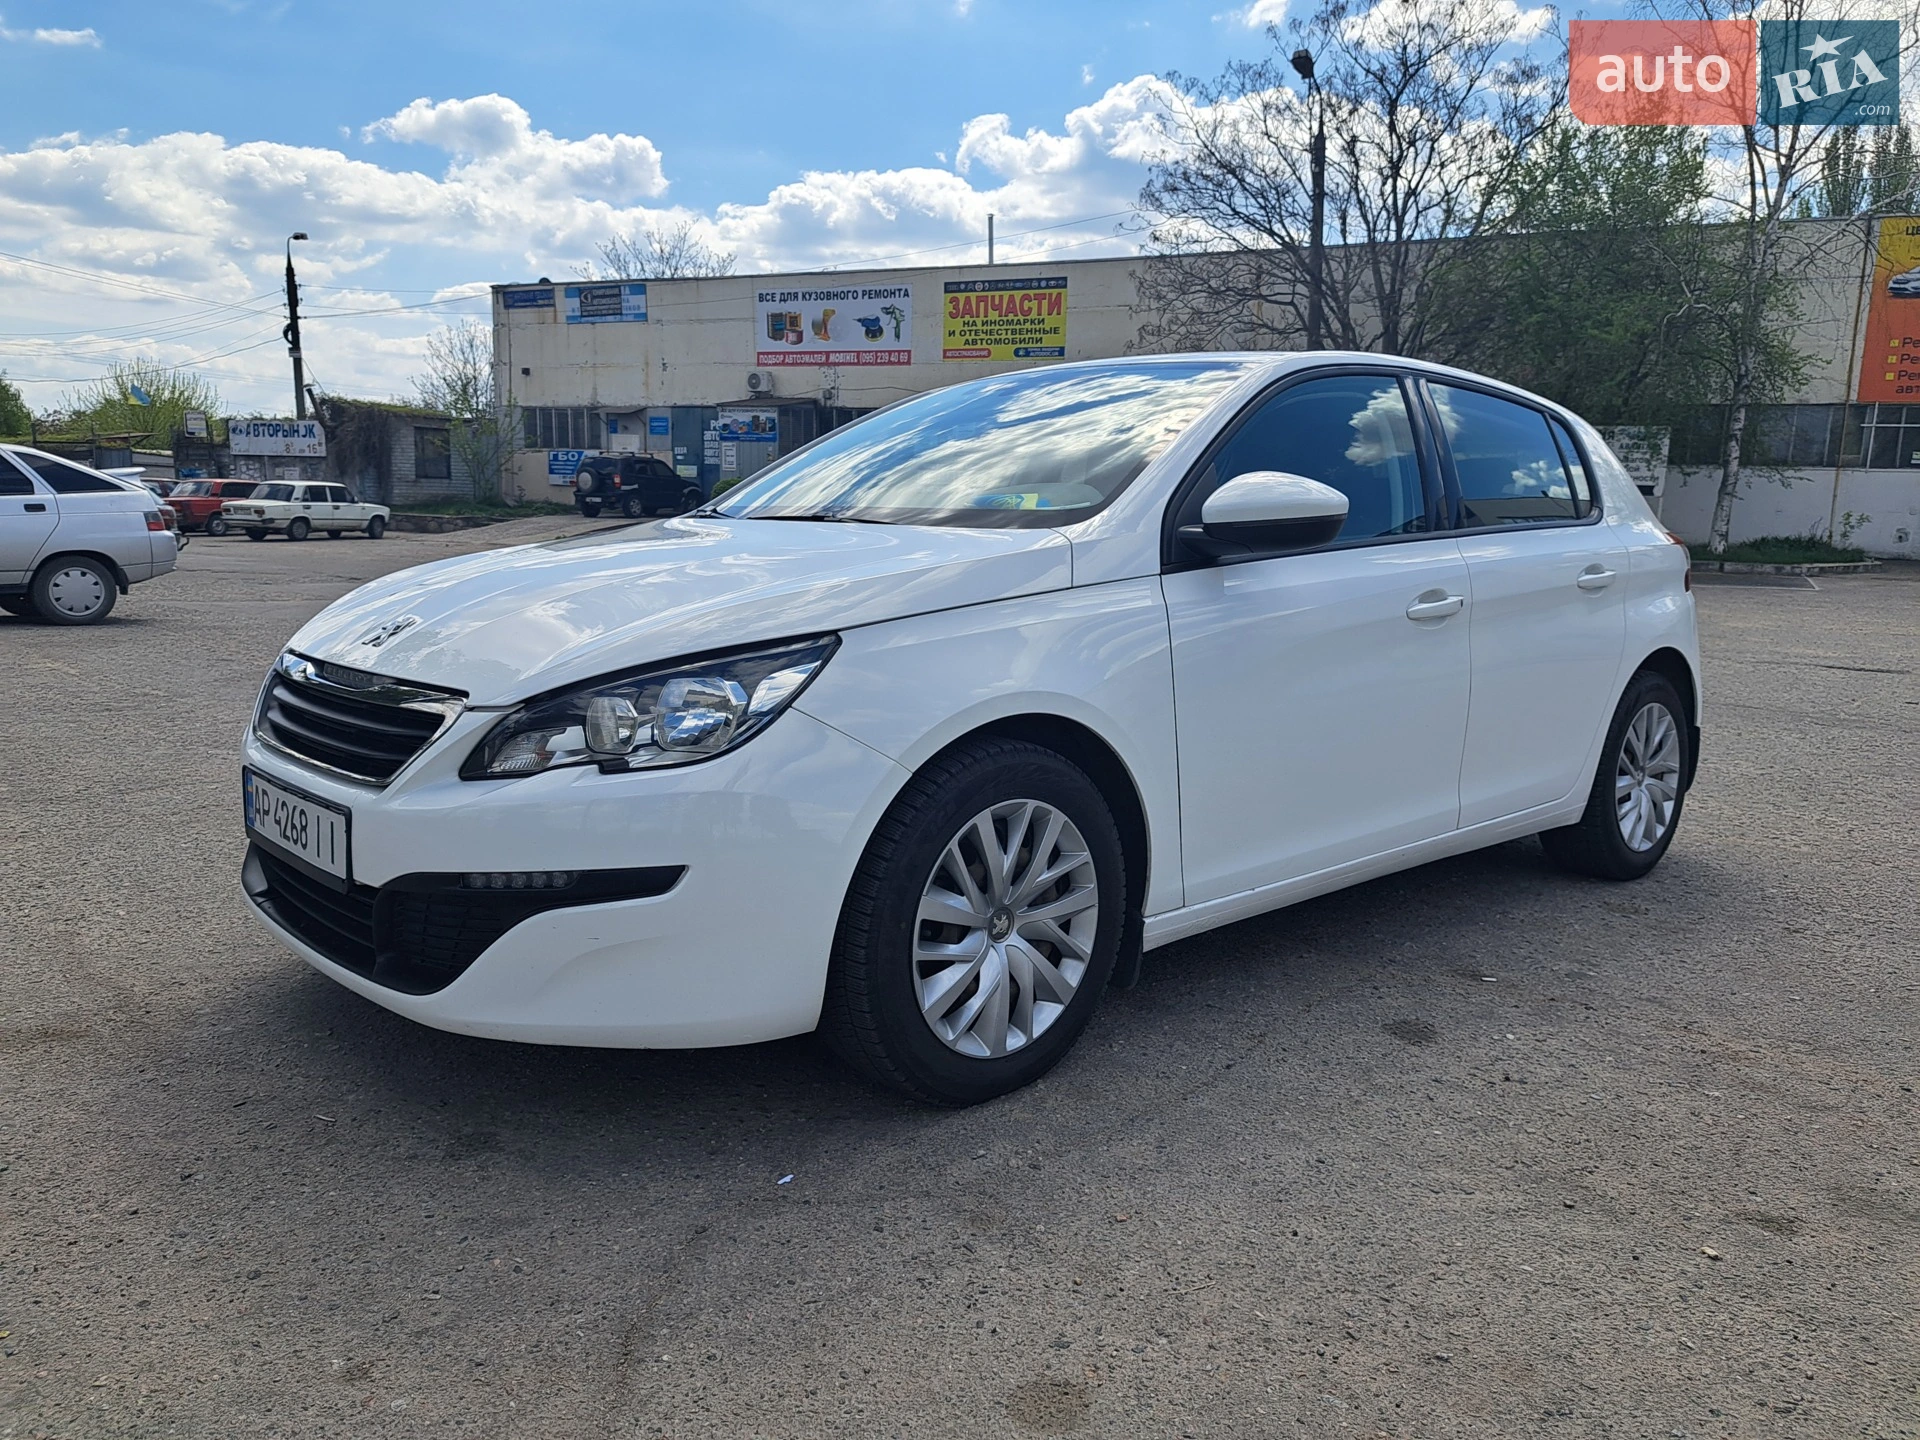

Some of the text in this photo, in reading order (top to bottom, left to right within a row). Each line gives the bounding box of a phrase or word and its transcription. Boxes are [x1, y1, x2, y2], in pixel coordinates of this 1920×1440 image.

[758, 288, 910, 304] ВСЕ ДЛЯ КУЗОВНОГО РЕМОНТА
[948, 292, 1062, 319] ЗАПЧАСТИ
[962, 318, 1045, 328] НА ИНОМАРКИ
[959, 327, 1060, 337] ОТЕЧЕСТВЕННЫЕ
[964, 337, 1042, 346] АВТОМОБИЛИ
[758, 355, 784, 365] ПОДБОР
[785, 353, 826, 364] АВТОЭМАЛЕЙ
[877, 352, 889, 362] 239
[890, 352, 899, 362] 40
[550, 452, 578, 460] ГБО
[255, 785, 270, 828] AP
[274, 798, 308, 850] 4268
